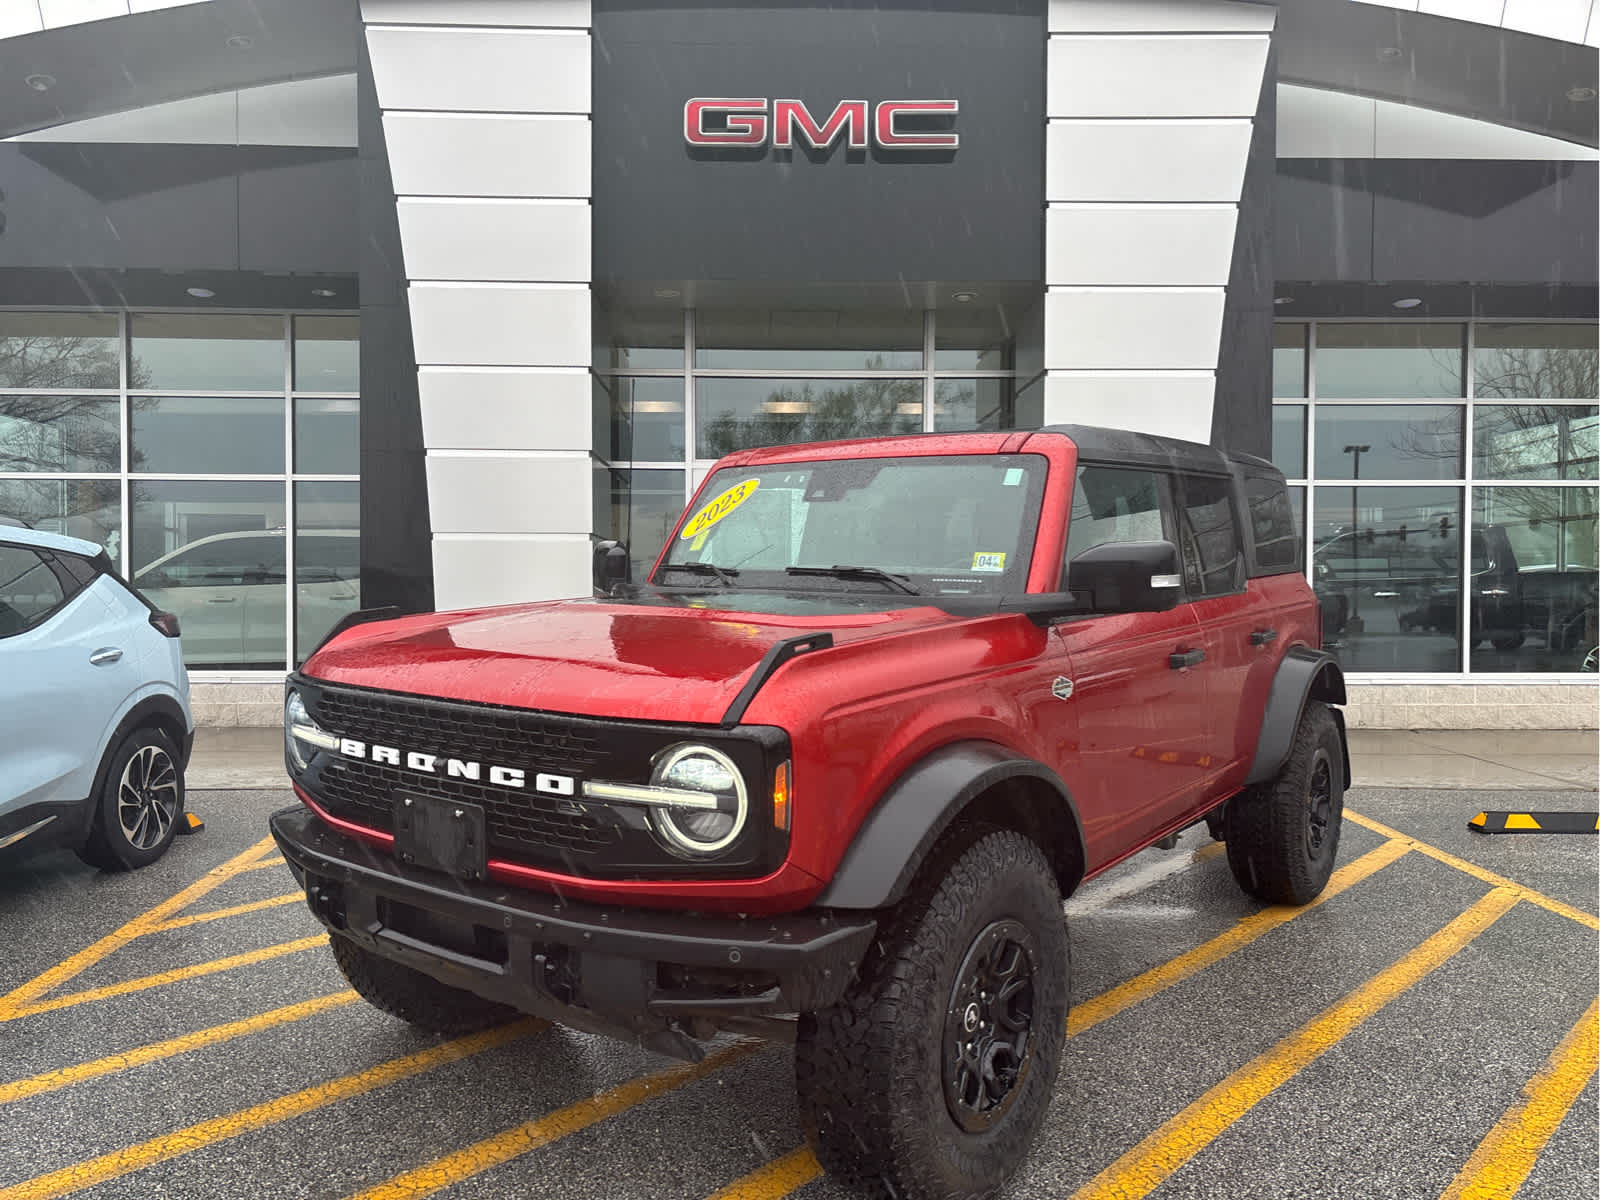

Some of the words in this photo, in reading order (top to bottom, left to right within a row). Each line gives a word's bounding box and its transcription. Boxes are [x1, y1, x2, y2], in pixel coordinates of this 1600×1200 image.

[684, 97, 959, 148] GMC
[695, 485, 746, 532] 2023
[340, 738, 574, 796] BRONCO
